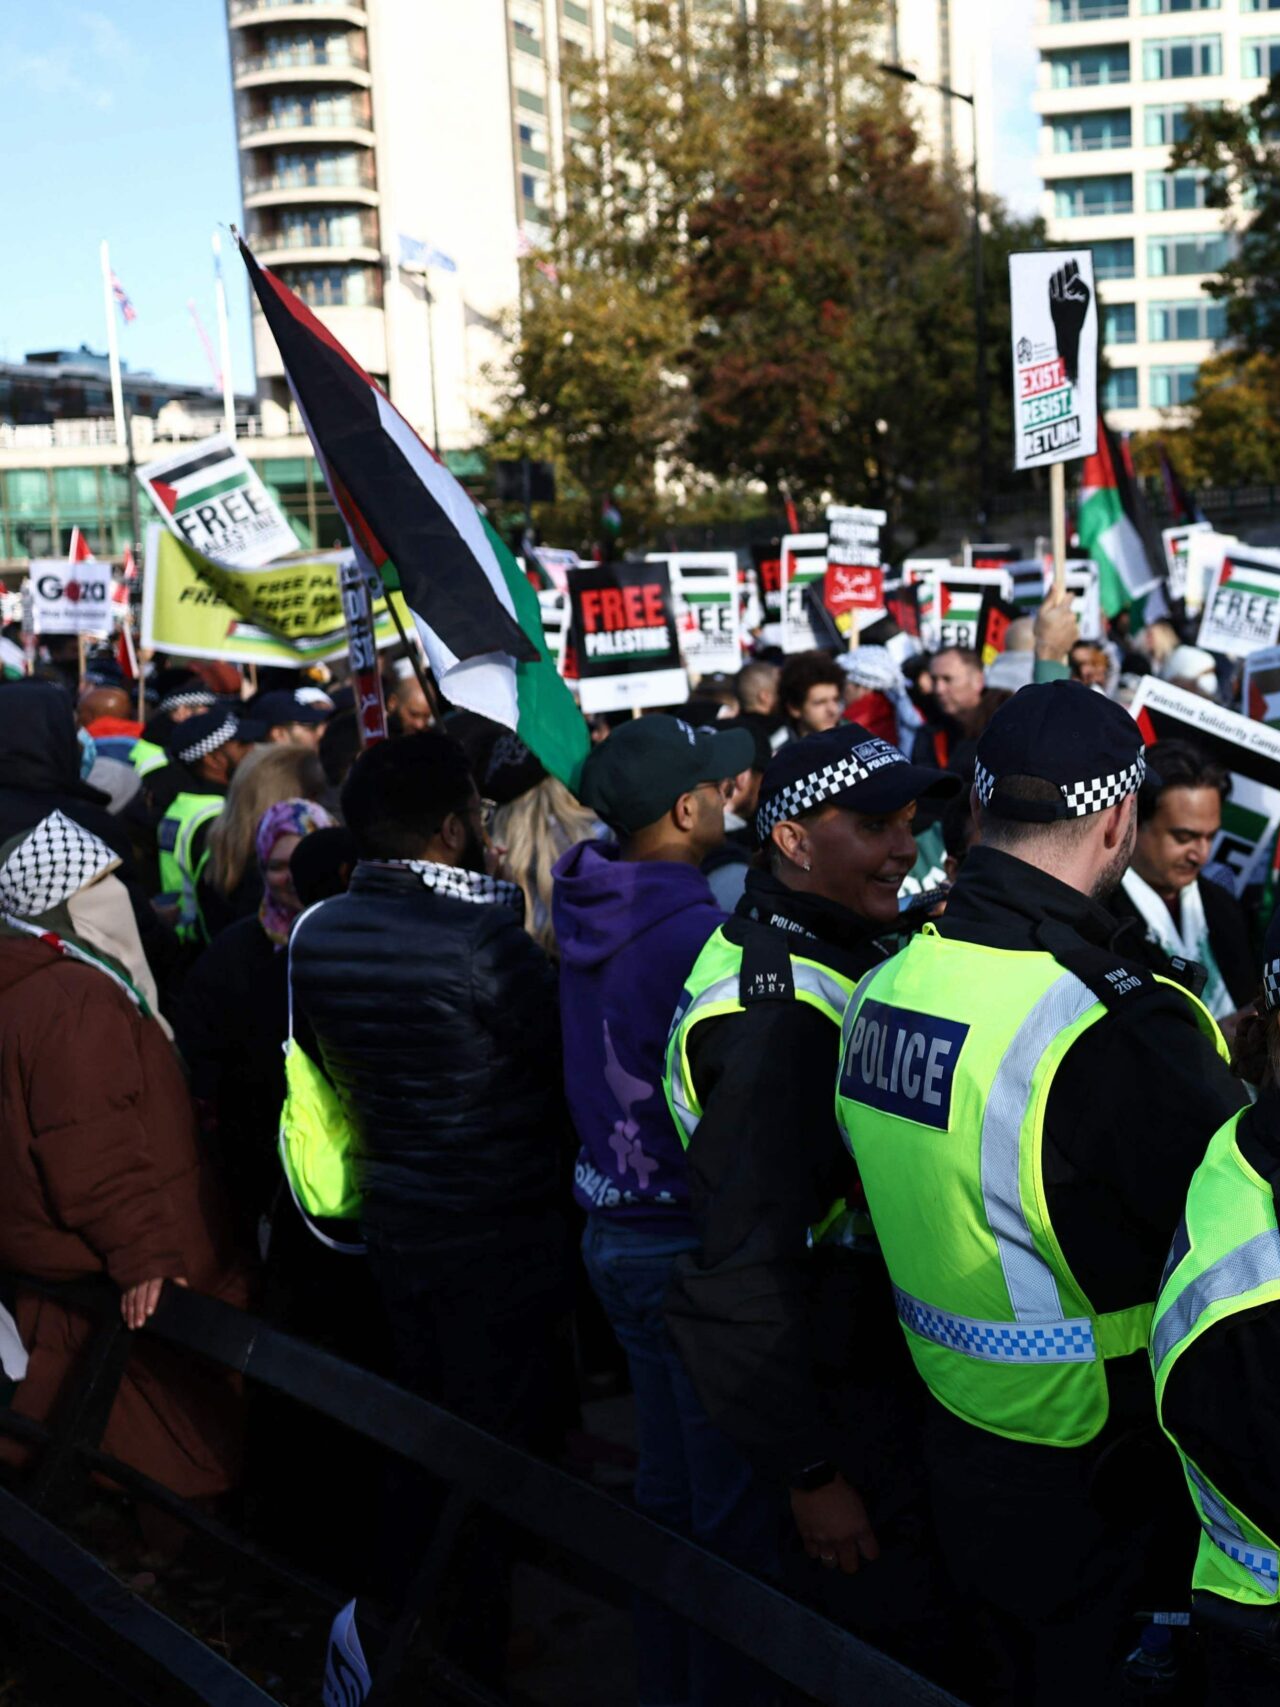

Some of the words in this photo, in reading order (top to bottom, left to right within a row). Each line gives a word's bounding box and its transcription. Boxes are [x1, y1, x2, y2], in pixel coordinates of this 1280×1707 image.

[1019, 362, 1066, 396] EXIST.
[1022, 389, 1071, 428] RESIST.
[175, 489, 265, 547] FREE
[256, 575, 304, 594] FREE
[580, 583, 667, 634] FREE
[1213, 589, 1279, 623] FREE
[584, 625, 671, 657] PALESTINE
[1146, 688, 1194, 717] Palestine
[1198, 710, 1248, 742] Solidarity
[770, 914, 805, 934] POLICE
[747, 983, 786, 996] 1287
[755, 972, 778, 984] NW
[1104, 967, 1128, 984] NW
[1114, 975, 1142, 995] 2610
[846, 1015, 952, 1107] POLICE
